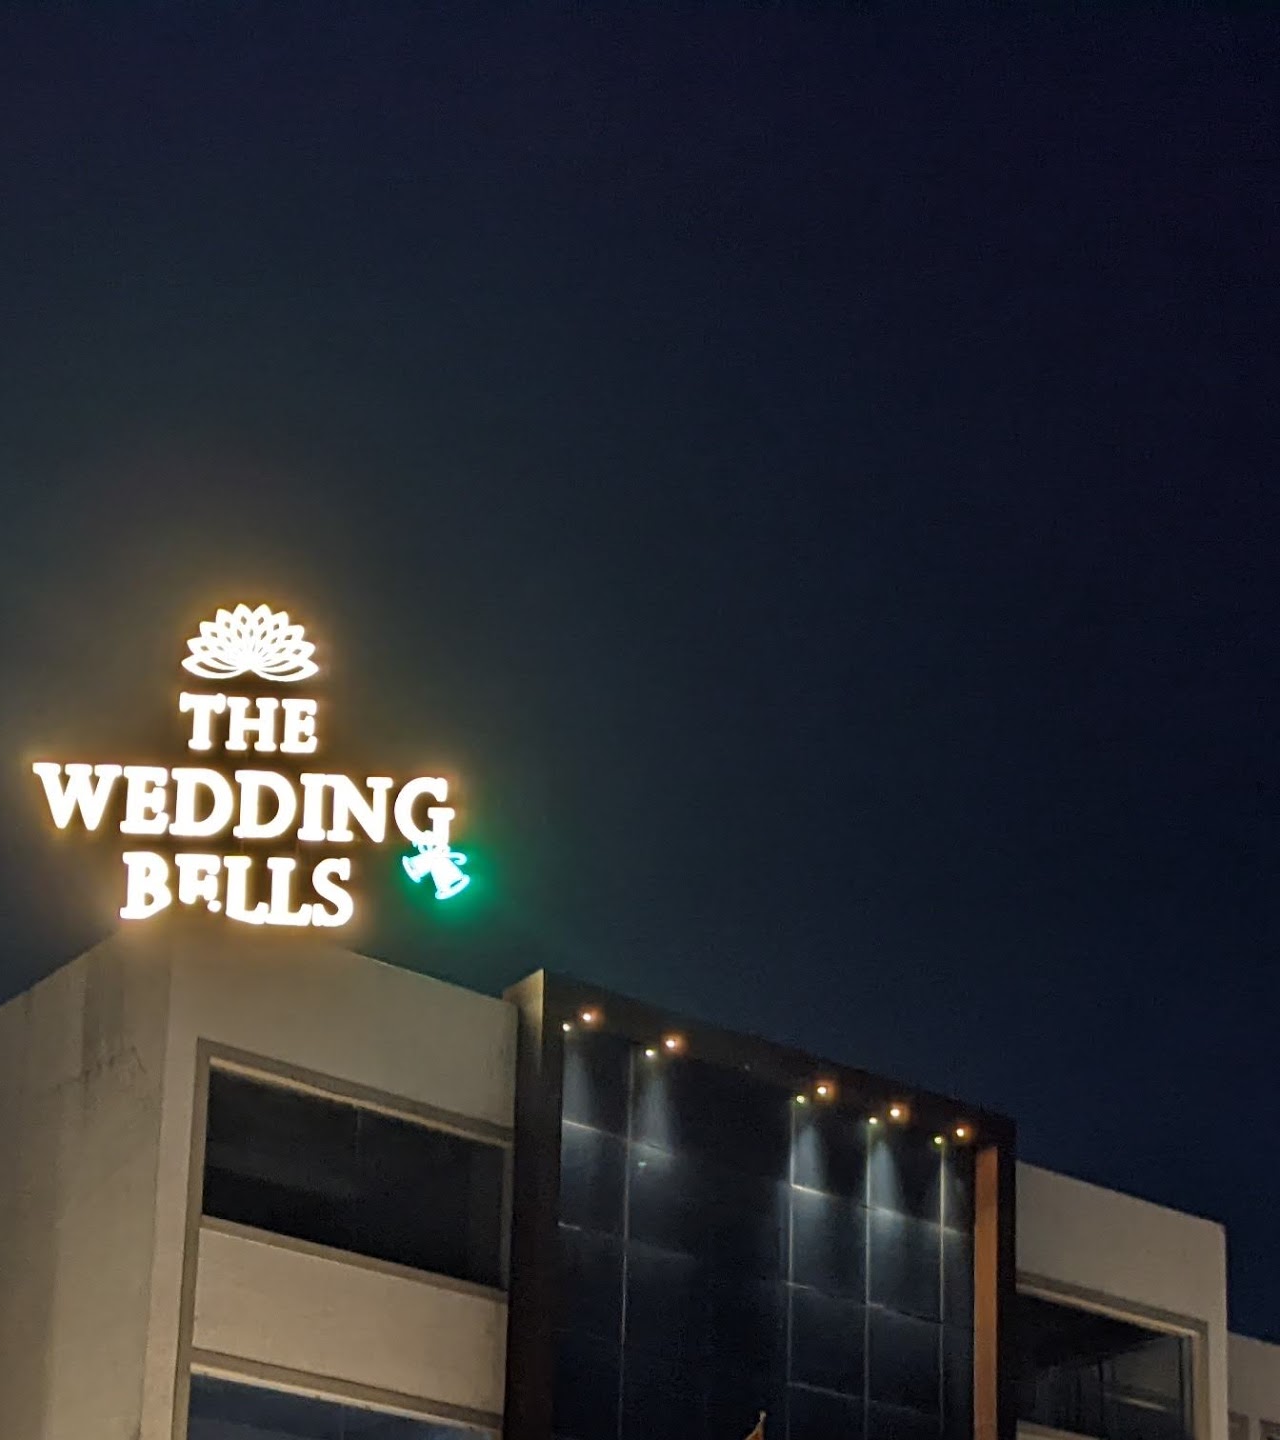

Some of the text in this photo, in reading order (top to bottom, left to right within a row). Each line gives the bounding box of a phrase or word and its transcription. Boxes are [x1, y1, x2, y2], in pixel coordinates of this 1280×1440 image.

[179, 691, 318, 753] THE
[32, 762, 455, 843] WEDDING
[119, 851, 354, 927] BELLS
